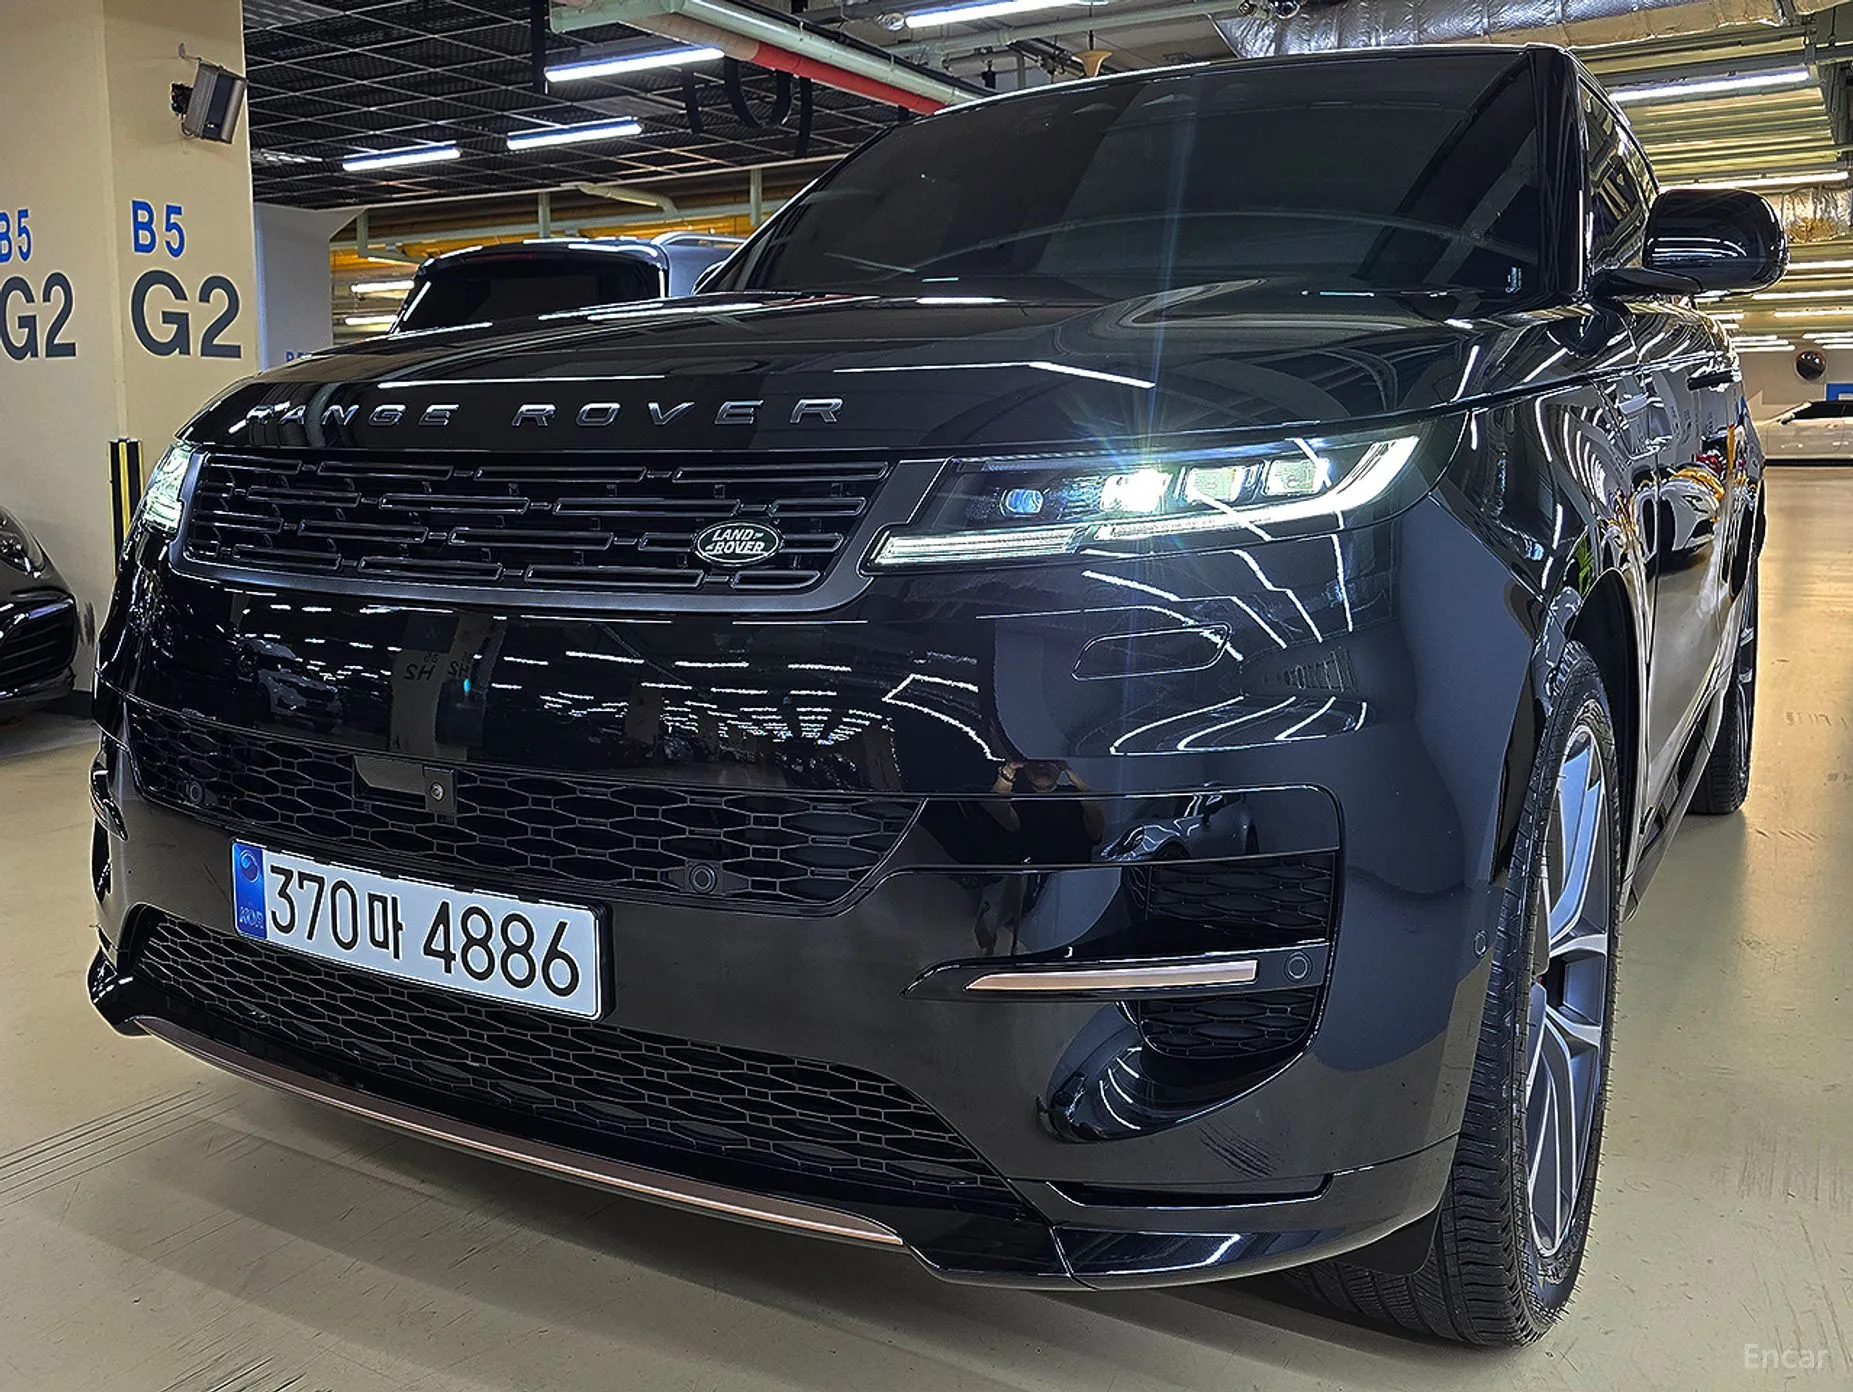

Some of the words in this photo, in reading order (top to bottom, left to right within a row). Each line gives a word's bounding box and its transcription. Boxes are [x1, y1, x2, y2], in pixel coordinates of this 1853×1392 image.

[0, 208, 32, 263] B5
[131, 199, 186, 258] B5
[0, 271, 77, 361] G2
[131, 269, 242, 360] G2
[247, 403, 460, 427] RANGE
[511, 398, 844, 427] ROVER
[712, 529, 754, 541] LAND
[713, 541, 766, 554] ROVER
[270, 864, 403, 960] 370마
[423, 900, 580, 997] 4886
